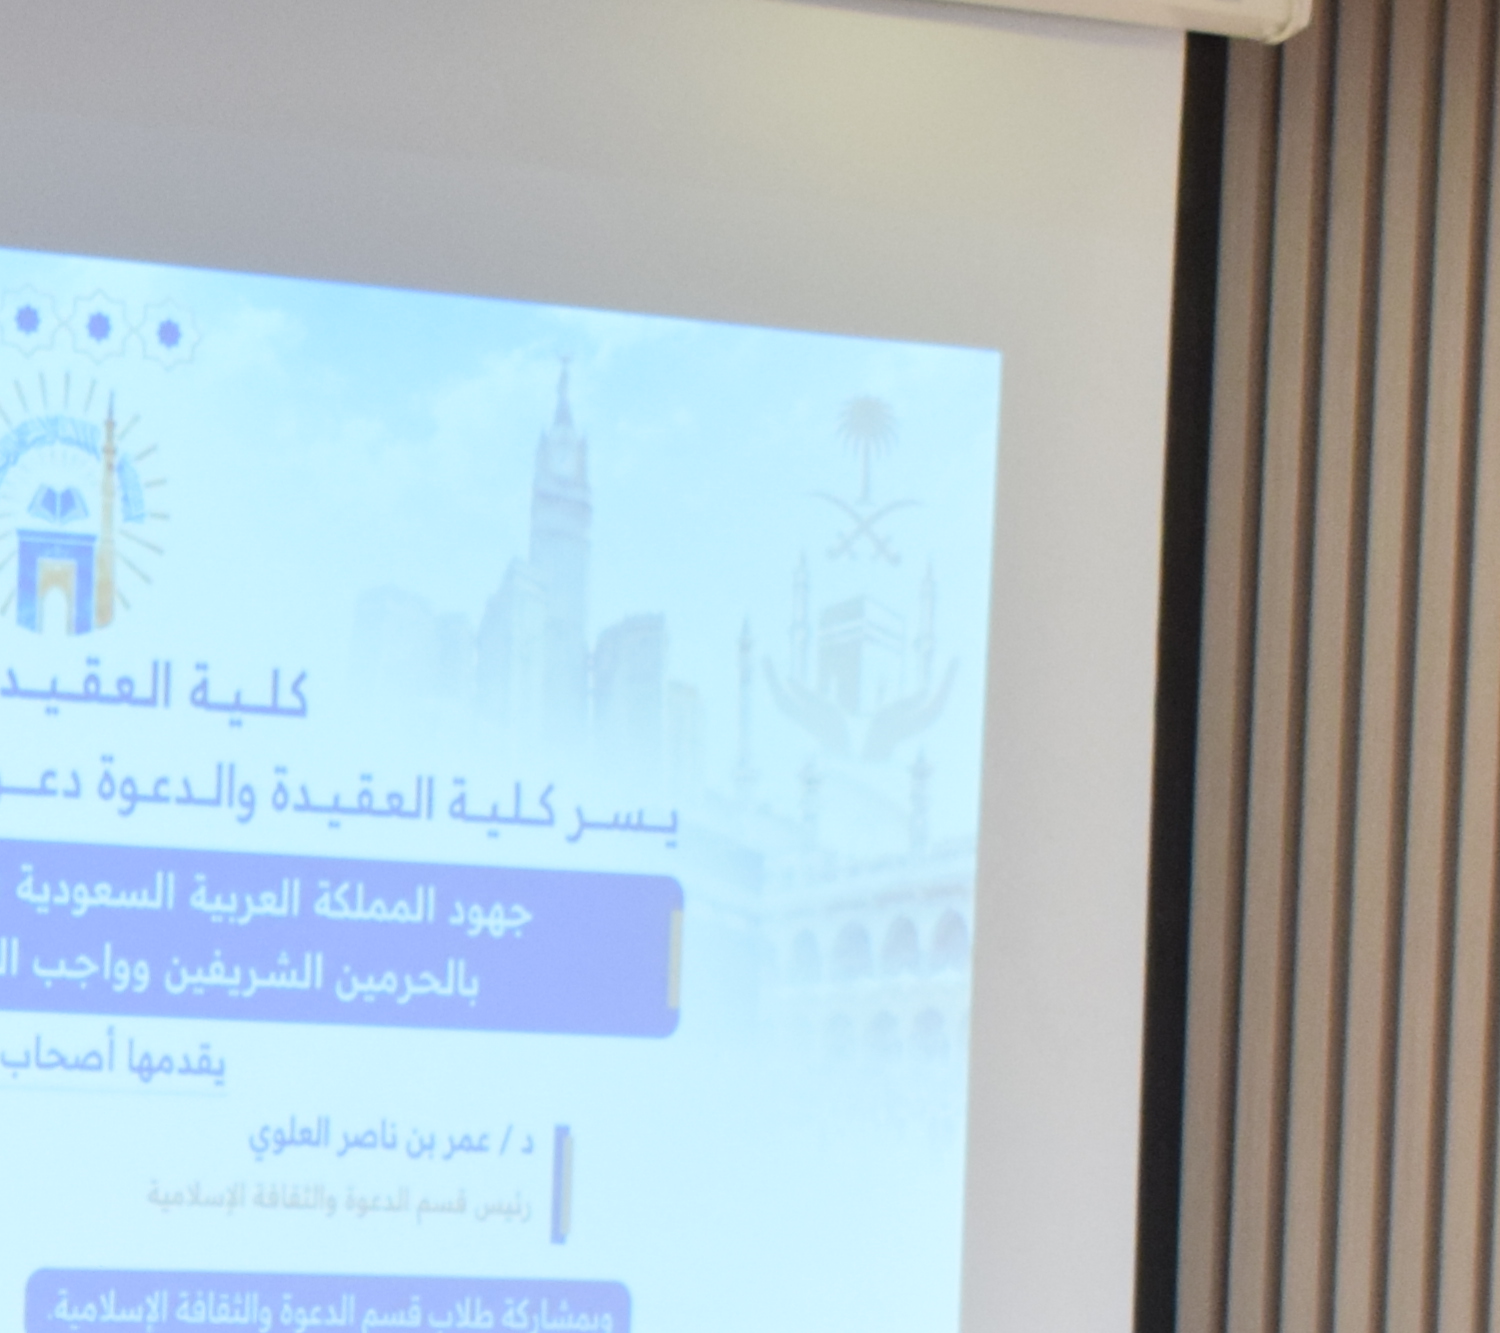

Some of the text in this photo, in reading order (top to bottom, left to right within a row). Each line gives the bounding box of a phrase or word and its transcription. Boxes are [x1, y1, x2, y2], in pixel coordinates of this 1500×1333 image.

[189, 662, 308, 727] كلية
[97, 754, 257, 824] والدعوة
[272, 766, 434, 828] العقيدة
[448, 777, 556, 838] كلية
[566, 807, 679, 849] يسر
[16, 864, 175, 917] السعودية
[190, 874, 300, 925] العربية
[314, 881, 435, 922] المملكة
[449, 896, 533, 938] جهود
[33, 942, 150, 993] وواجب
[165, 950, 323, 997] الشريفين
[336, 959, 479, 1006] بالحرمين
[0, 1025, 115, 1078] أصحاب
[128, 1039, 226, 1086] يقدمها
[249, 1116, 330, 1161] العلوي
[337, 1119, 398, 1157] ناصر
[406, 1126, 436, 1159] بن
[442, 1129, 489, 1160] عمر
[176, 1292, 272, 1333] والثقافة
